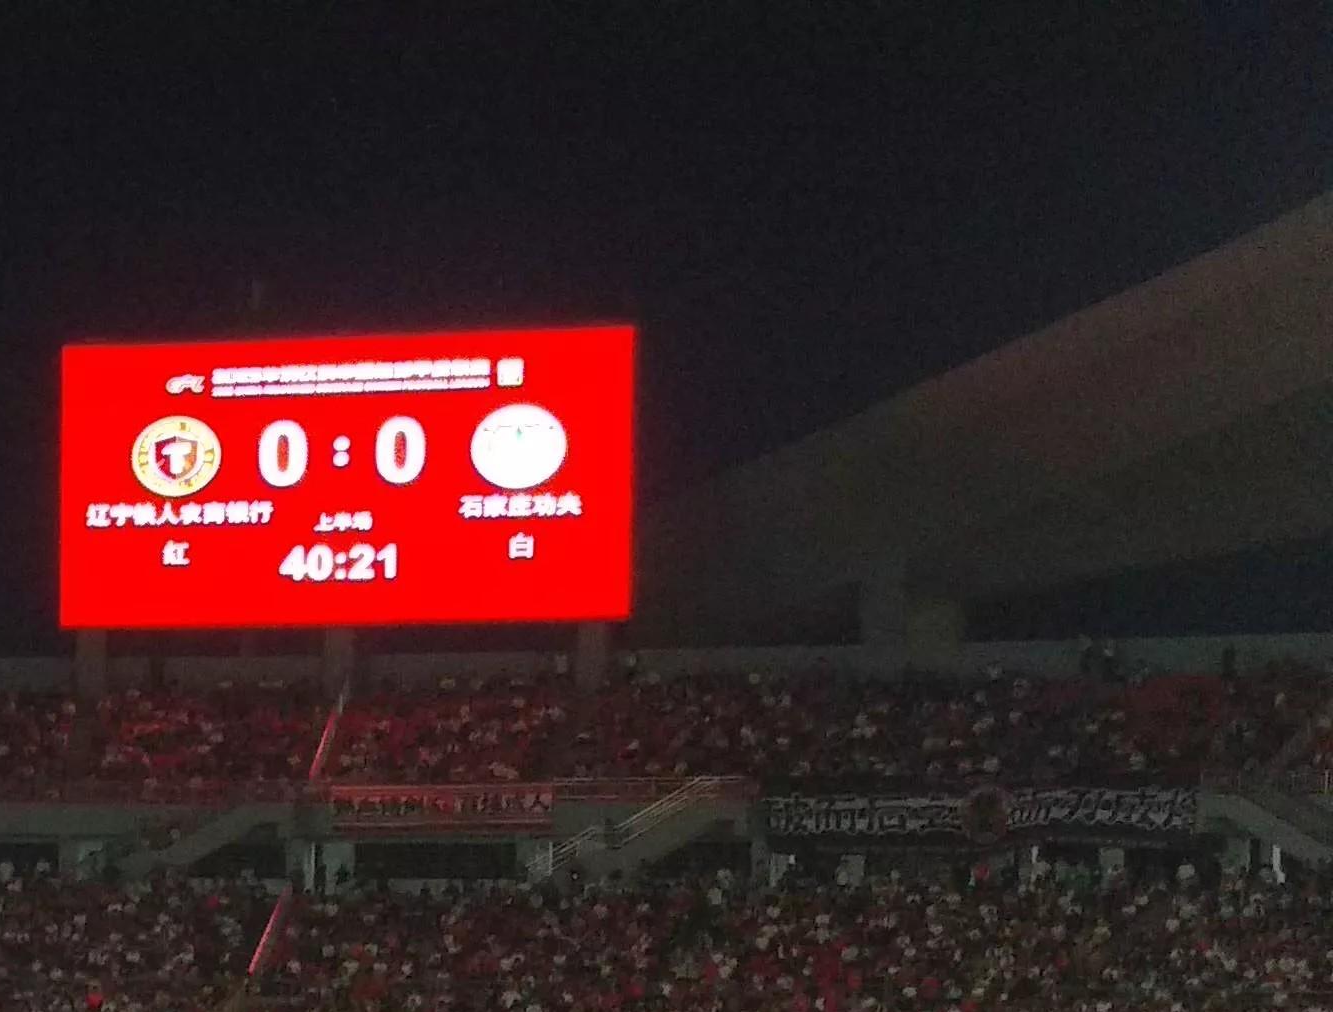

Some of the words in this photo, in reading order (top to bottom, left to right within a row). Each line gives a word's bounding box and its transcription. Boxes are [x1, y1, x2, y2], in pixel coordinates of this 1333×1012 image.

[258, 418, 308, 488] 0
[375, 415, 427, 485] 0
[458, 491, 583, 518] 石家庄功夫
[312, 511, 374, 532] 上半场
[161, 540, 191, 567] 红
[508, 532, 535, 561] 白
[277, 543, 399, 582] 40:21
